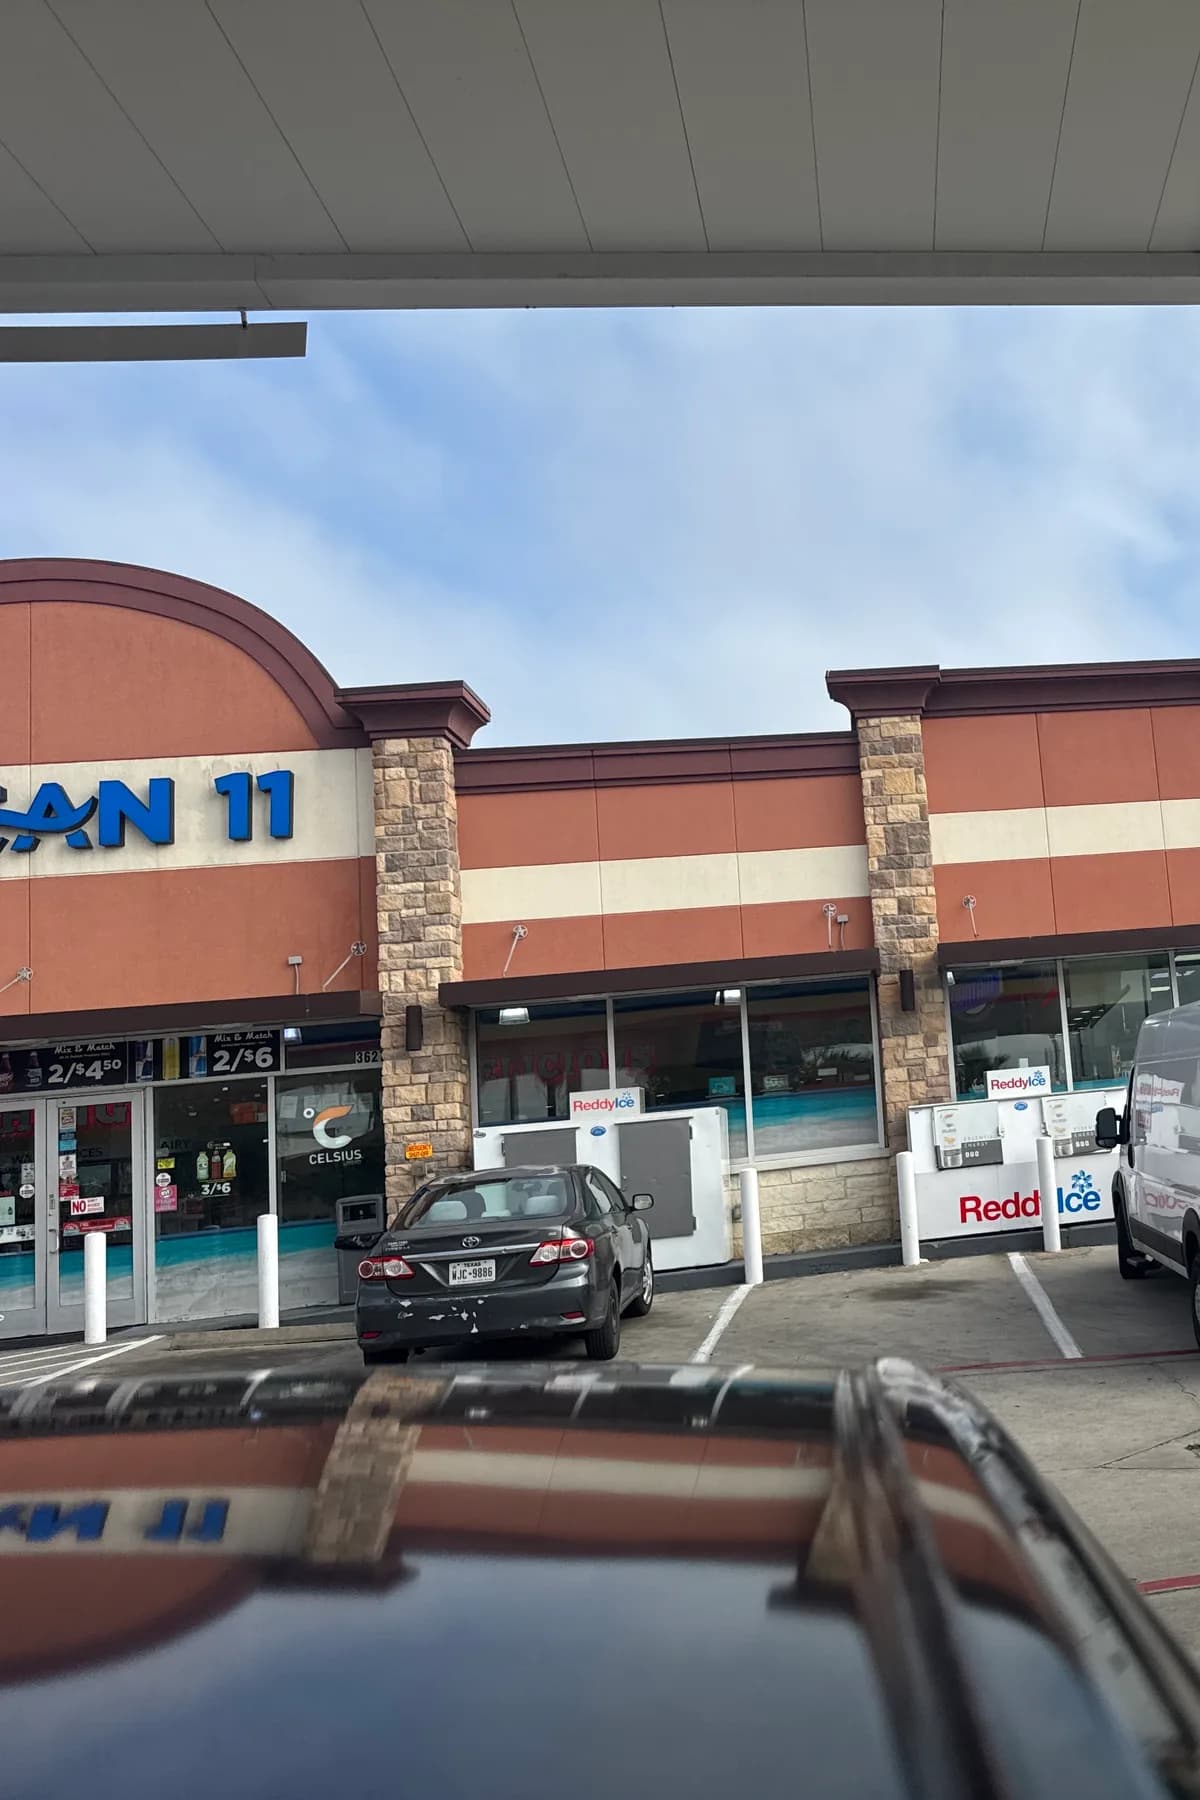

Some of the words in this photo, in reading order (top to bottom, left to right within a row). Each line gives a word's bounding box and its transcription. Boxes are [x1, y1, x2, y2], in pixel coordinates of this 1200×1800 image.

[0, 778, 175, 854] AN
[214, 770, 294, 842] 11
[212, 1046, 274, 1072] 2/$6
[308, 1149, 362, 1165] CELSIUS
[201, 1182, 231, 1196] 3/$6
[72, 1200, 87, 1213] NO
[959, 1187, 1101, 1224] ReddIce
